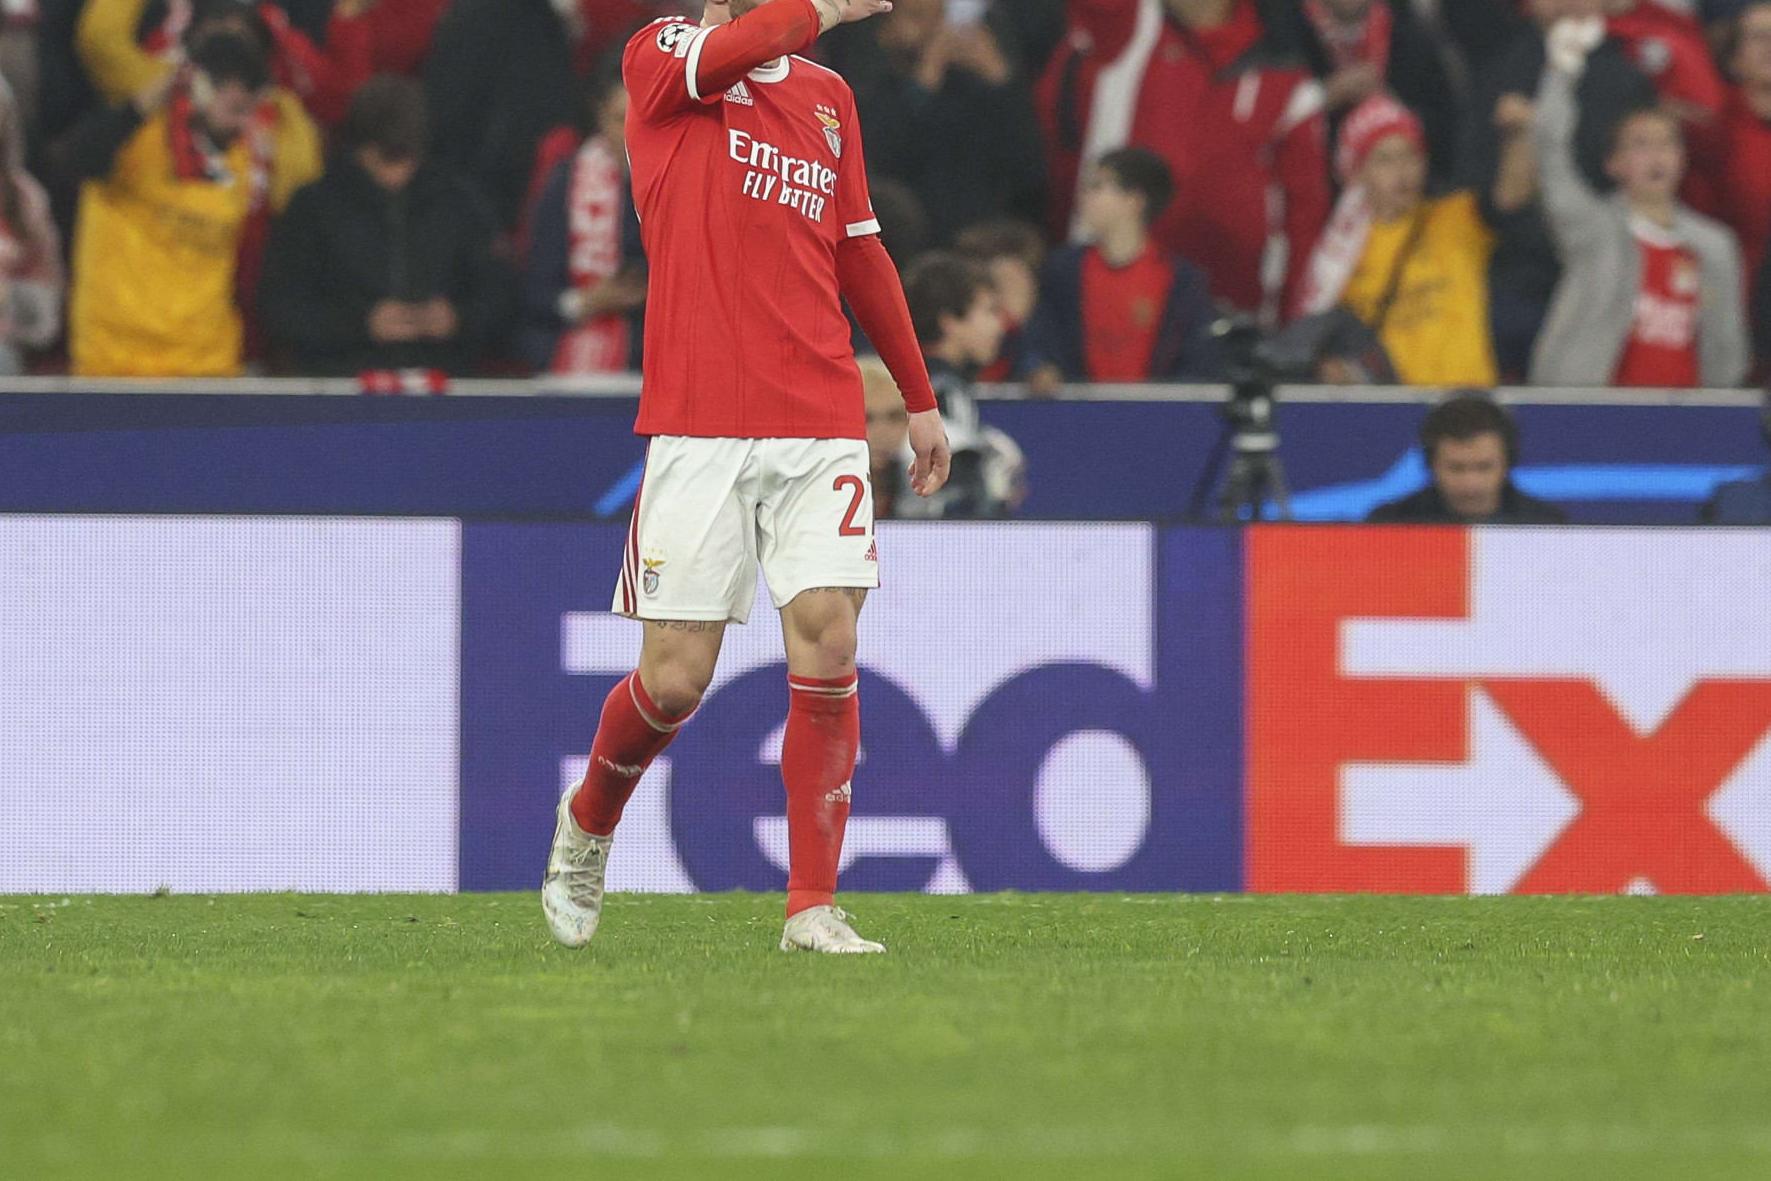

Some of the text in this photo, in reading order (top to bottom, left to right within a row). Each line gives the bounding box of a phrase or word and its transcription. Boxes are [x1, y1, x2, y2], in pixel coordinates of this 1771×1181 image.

[728, 128, 837, 197] Emirates
[742, 170, 777, 201] FLY
[832, 474, 870, 537] 2
[460, 525, 1771, 893] FedEx
